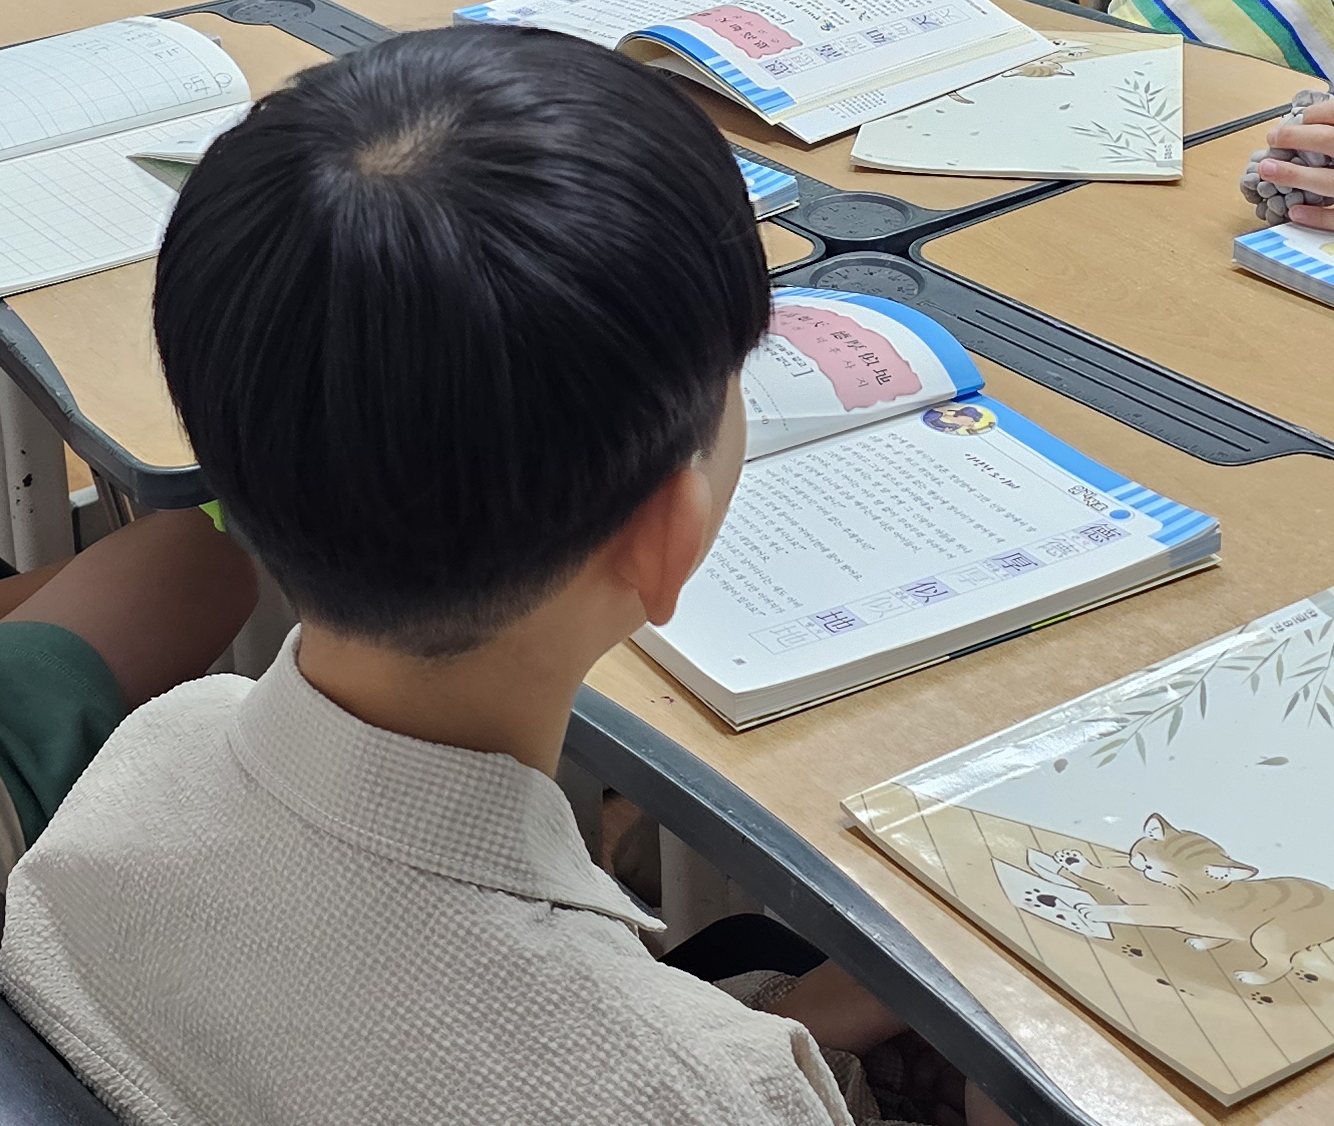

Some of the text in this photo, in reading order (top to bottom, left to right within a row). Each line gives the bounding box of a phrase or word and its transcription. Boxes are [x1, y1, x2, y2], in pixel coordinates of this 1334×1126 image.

[1079, 523, 1122, 543] 德
[992, 552, 1038, 572] 厚
[905, 578, 948, 604] 似
[816, 609, 857, 634] 地
